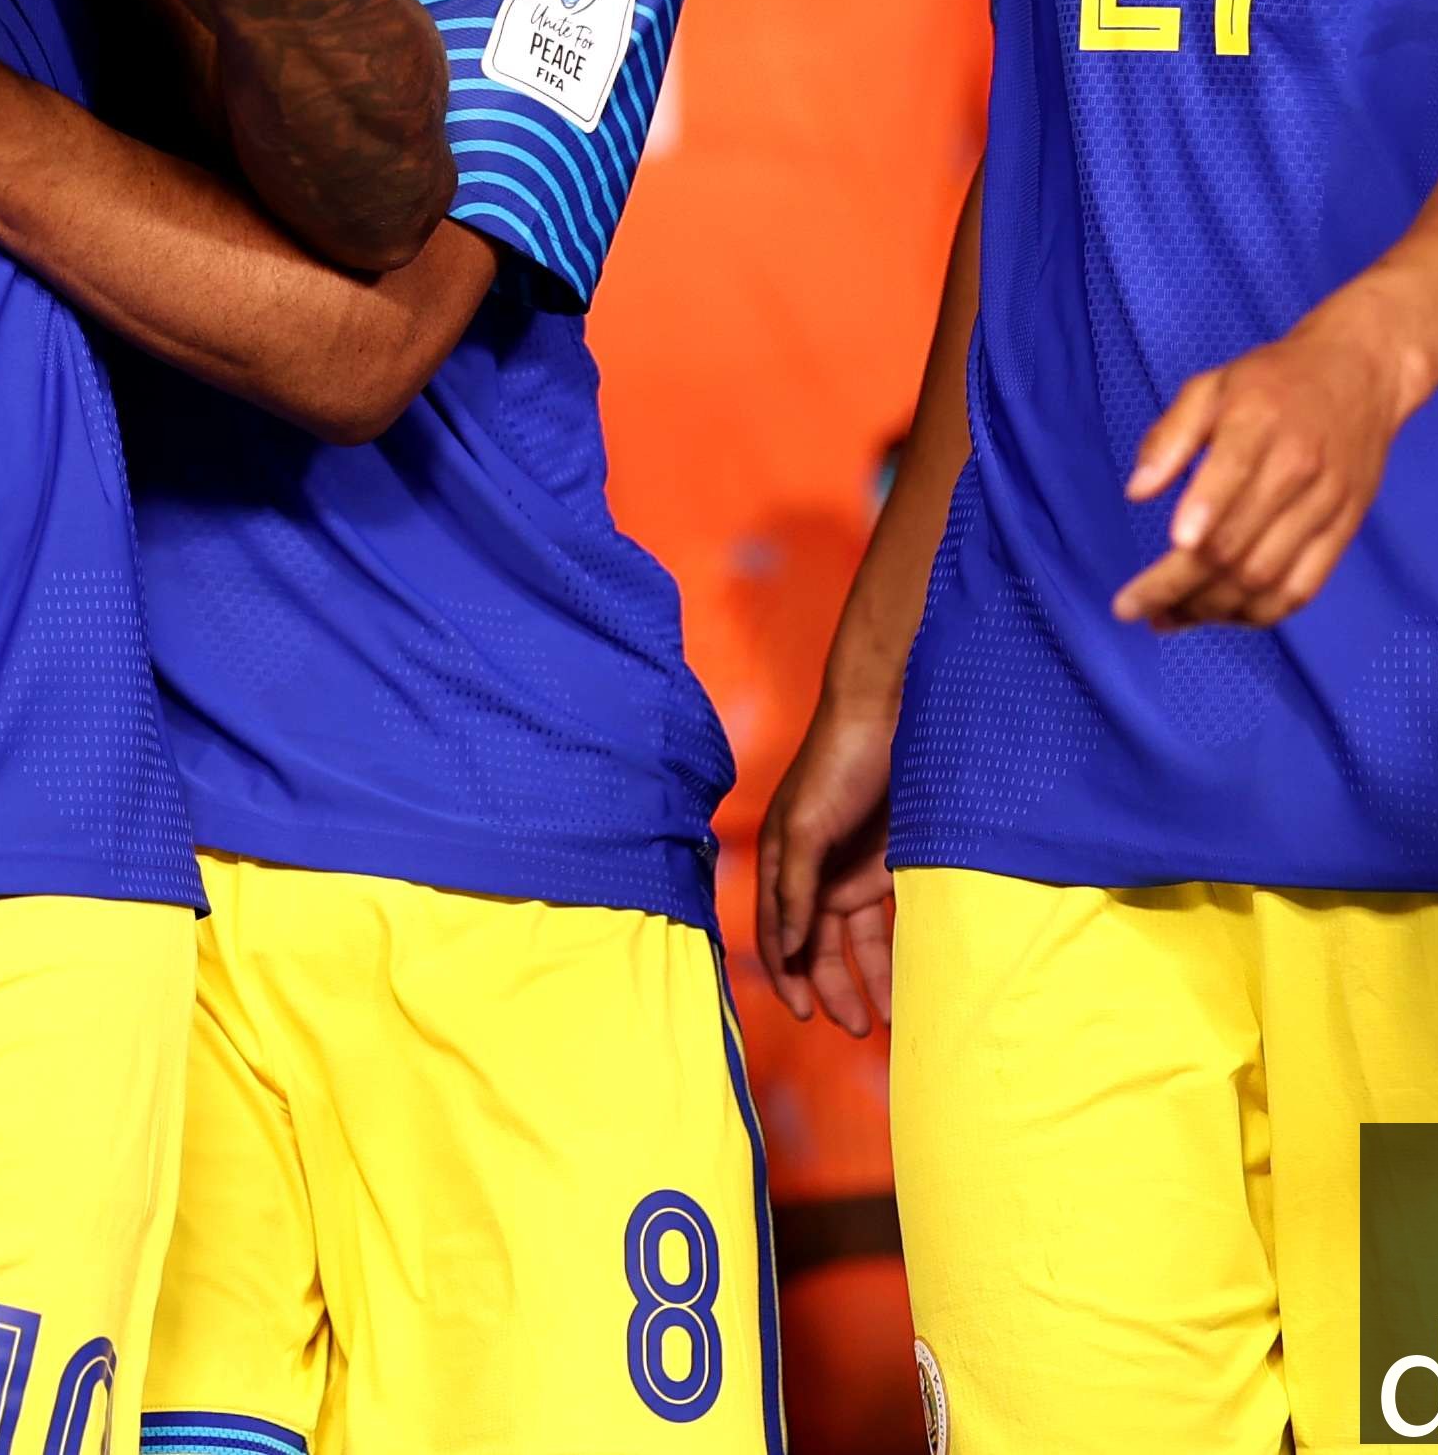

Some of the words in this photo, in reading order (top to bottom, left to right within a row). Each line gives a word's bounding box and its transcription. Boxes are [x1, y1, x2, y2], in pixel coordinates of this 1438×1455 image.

[531, 3, 573, 39] Unite
[575, 24, 596, 50] For
[529, 31, 587, 82] PEACE
[536, 66, 564, 92] FIFA
[624, 1188, 720, 1423] 8
